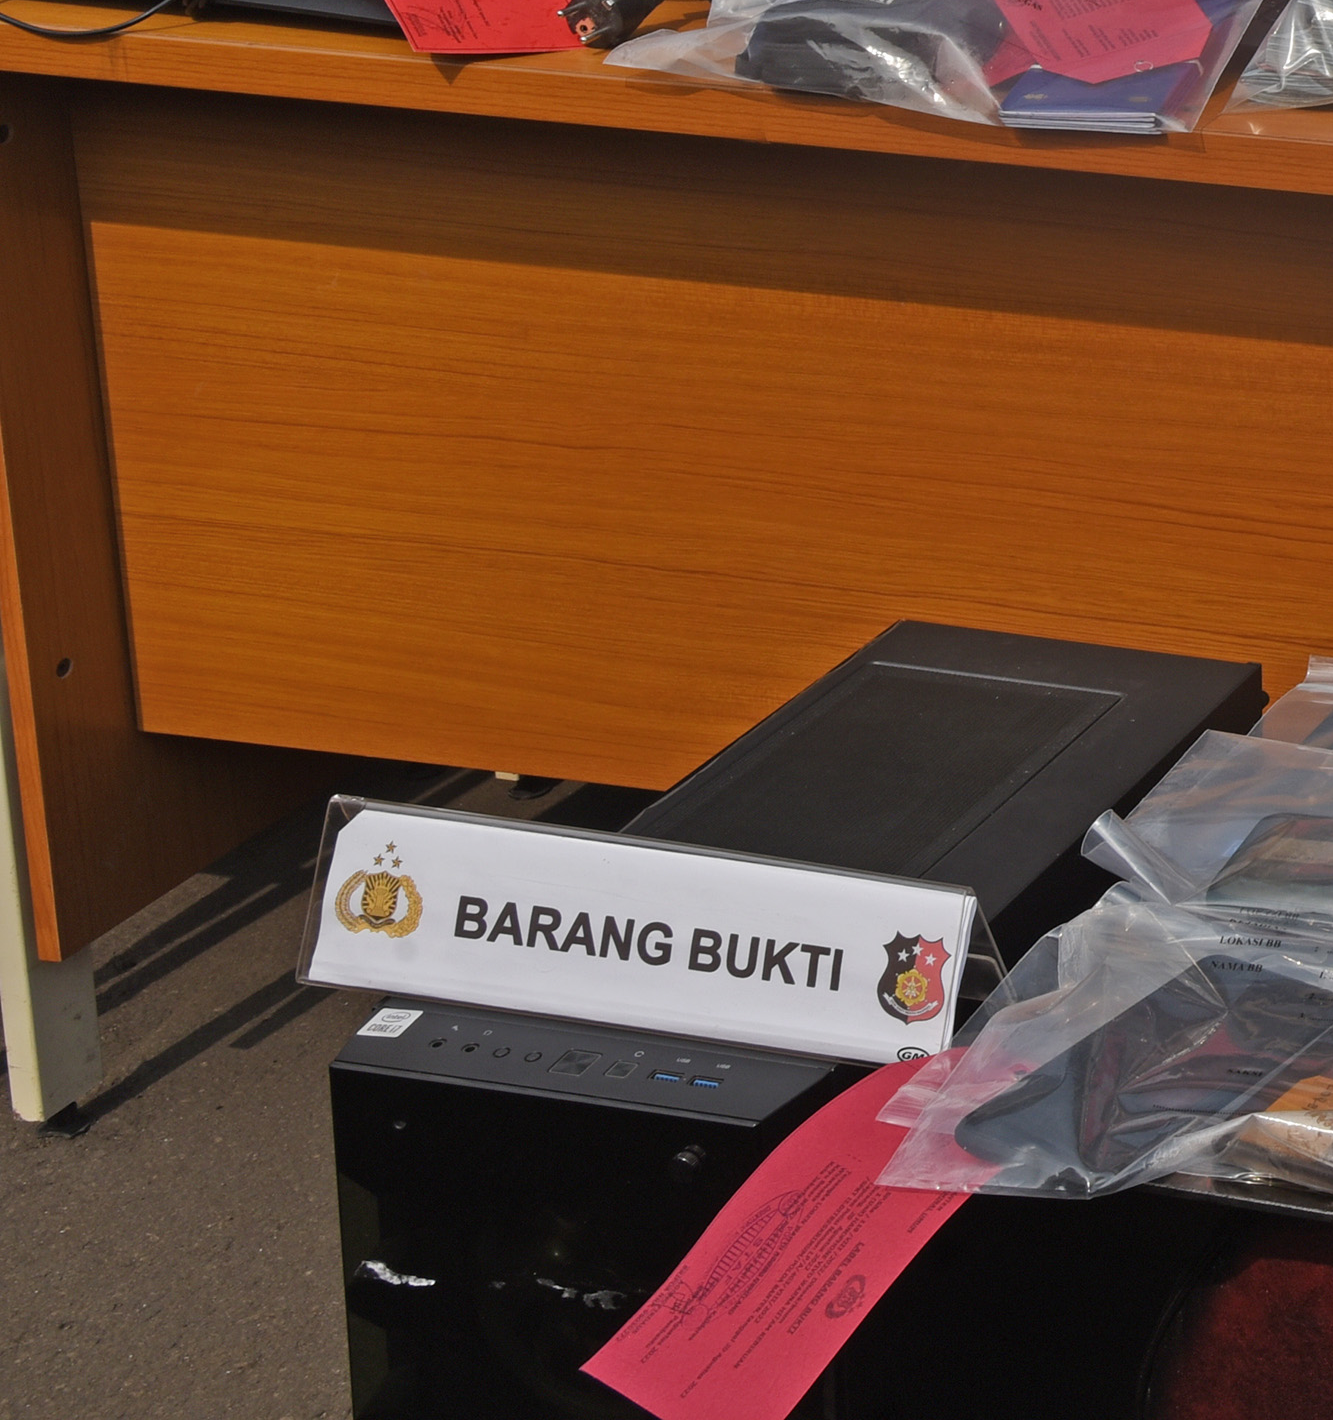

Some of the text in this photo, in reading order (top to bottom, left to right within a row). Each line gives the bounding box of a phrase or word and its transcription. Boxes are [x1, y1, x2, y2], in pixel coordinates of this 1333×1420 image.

[454, 895, 844, 992] BARANG BUKTI
[1220, 935, 1282, 949] LOKASI BB
[1211, 960, 1263, 973] NAMA BB
[808, 1268, 844, 1307] BARANG
[785, 1305, 813, 1337] BUKTI
